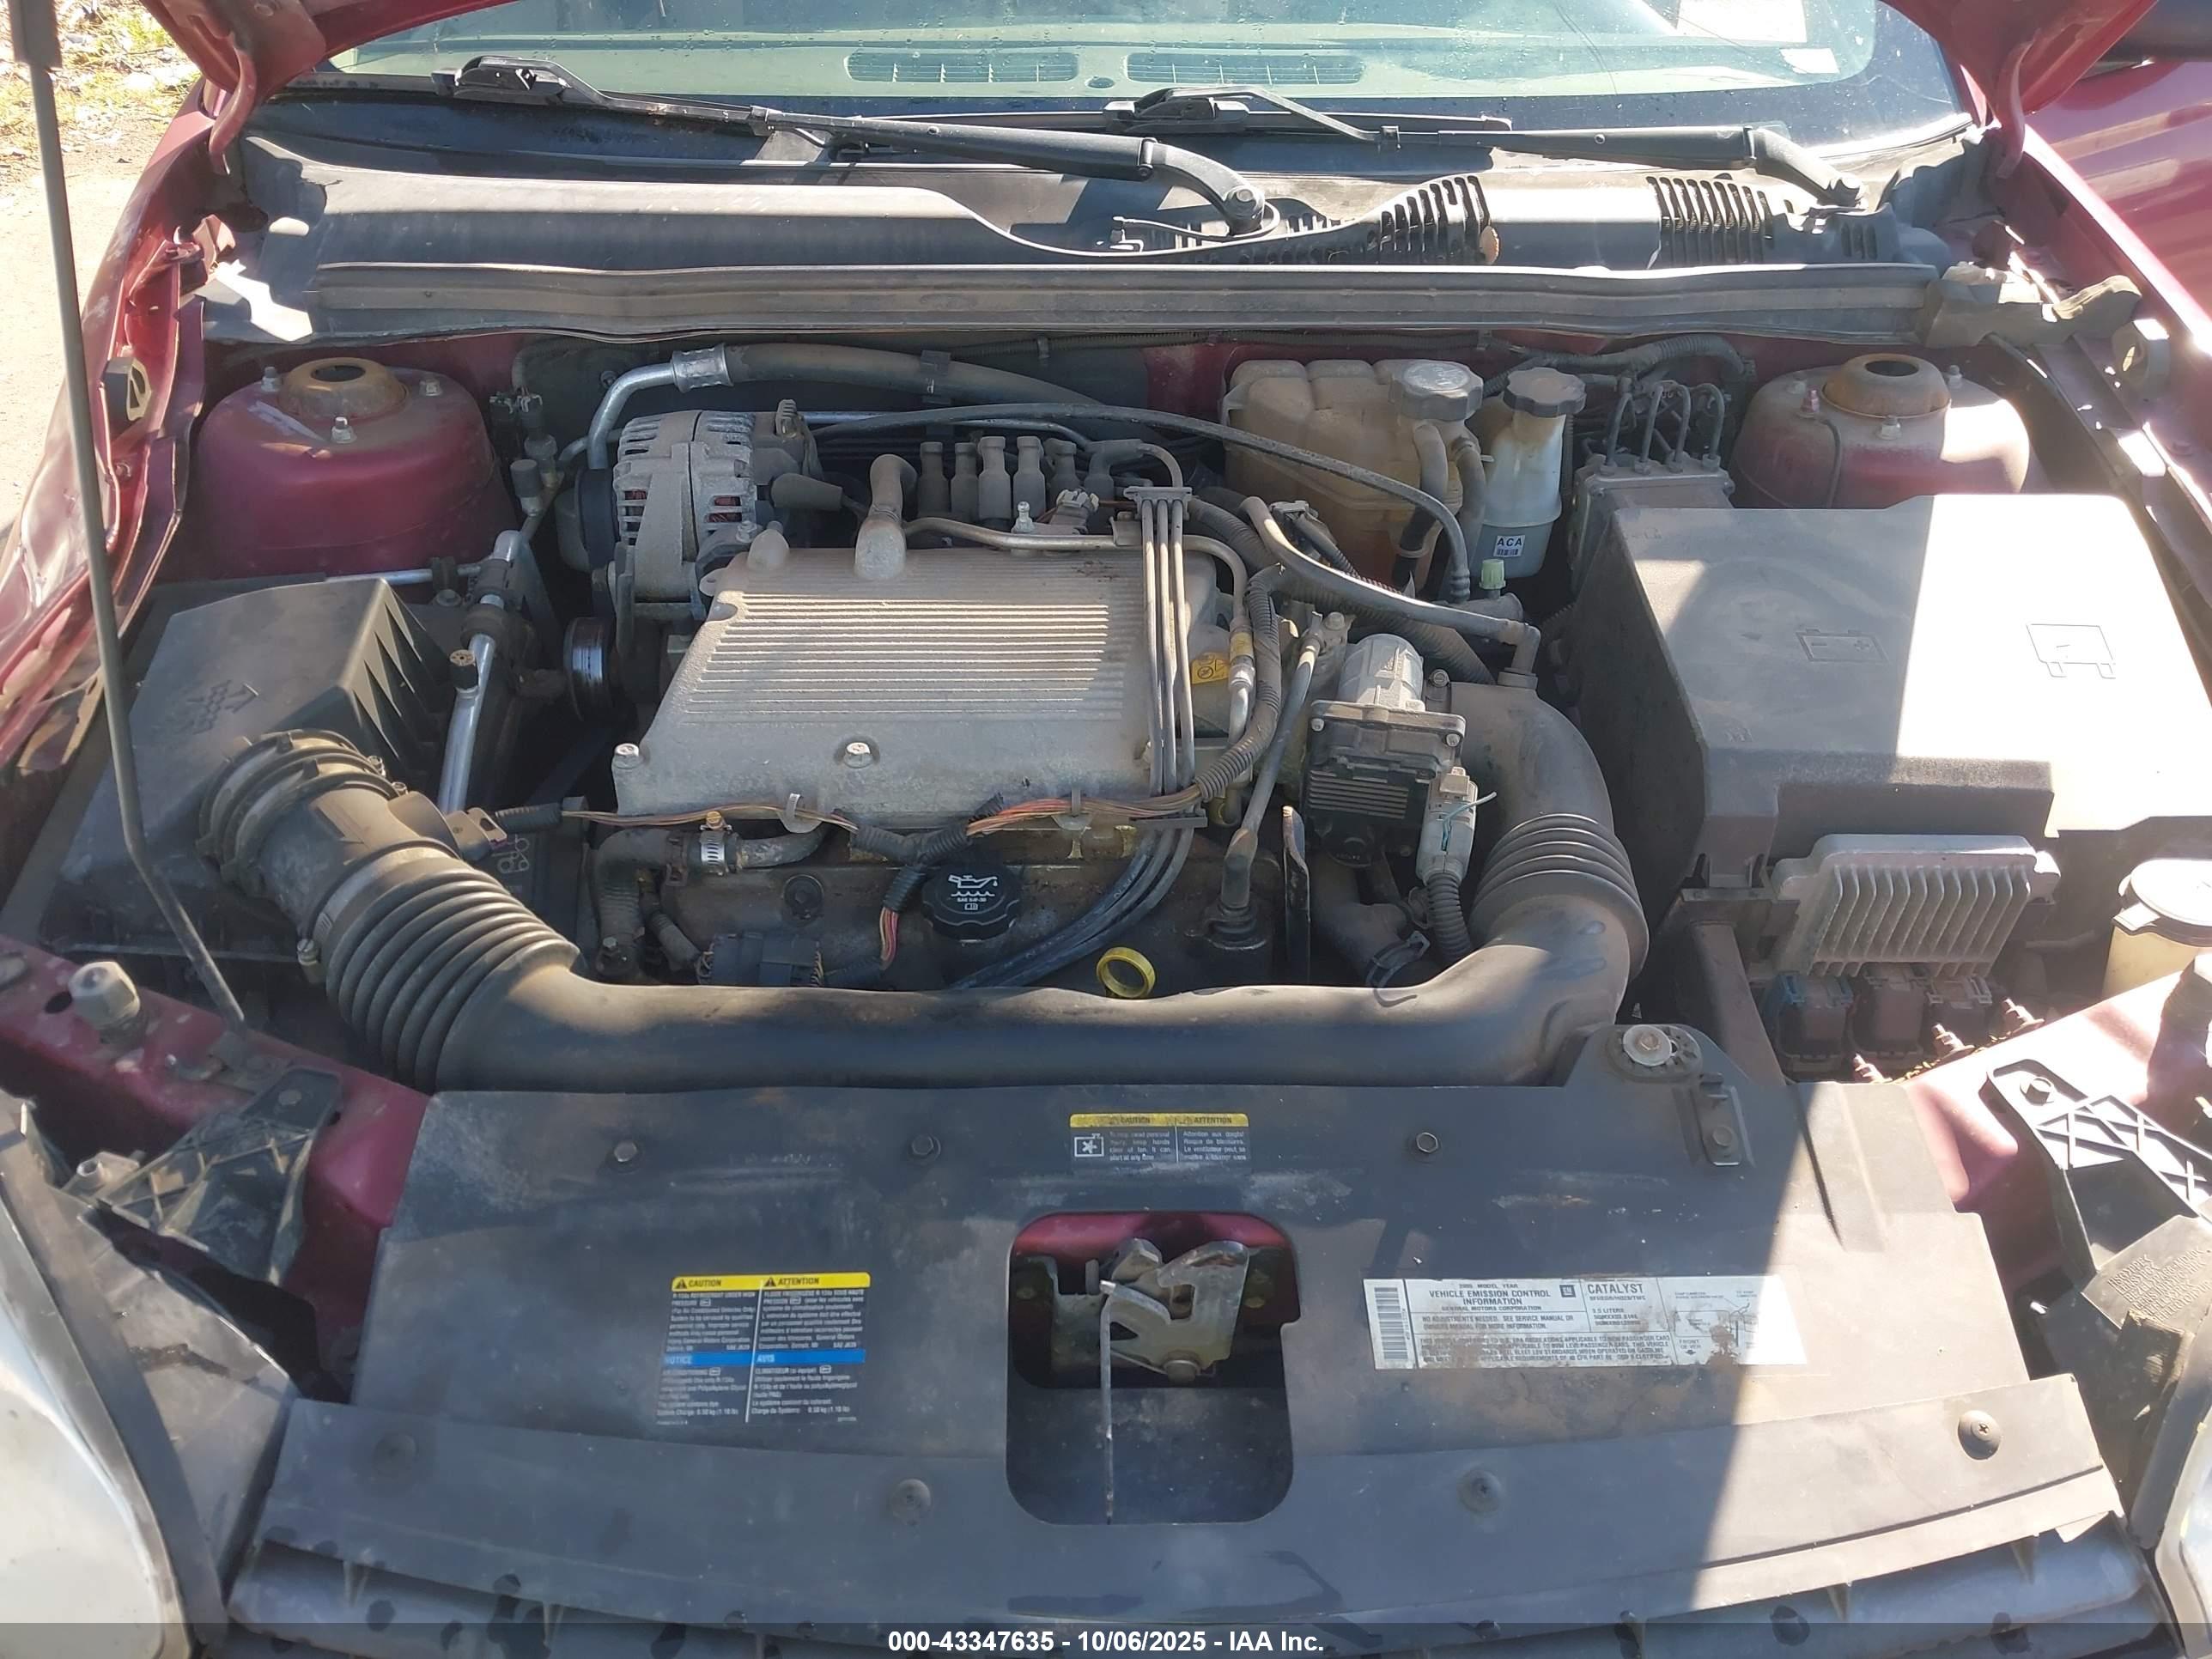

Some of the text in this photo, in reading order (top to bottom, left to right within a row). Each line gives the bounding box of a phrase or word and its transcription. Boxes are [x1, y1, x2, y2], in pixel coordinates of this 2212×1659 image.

[1497, 538, 1522, 547] ACA
[778, 1277, 820, 1285] ATTENTION
[1587, 1284, 1644, 1294] CATALYST
[664, 1355, 693, 1364] NOTICE
[757, 1354, 775, 1363] AVIS
